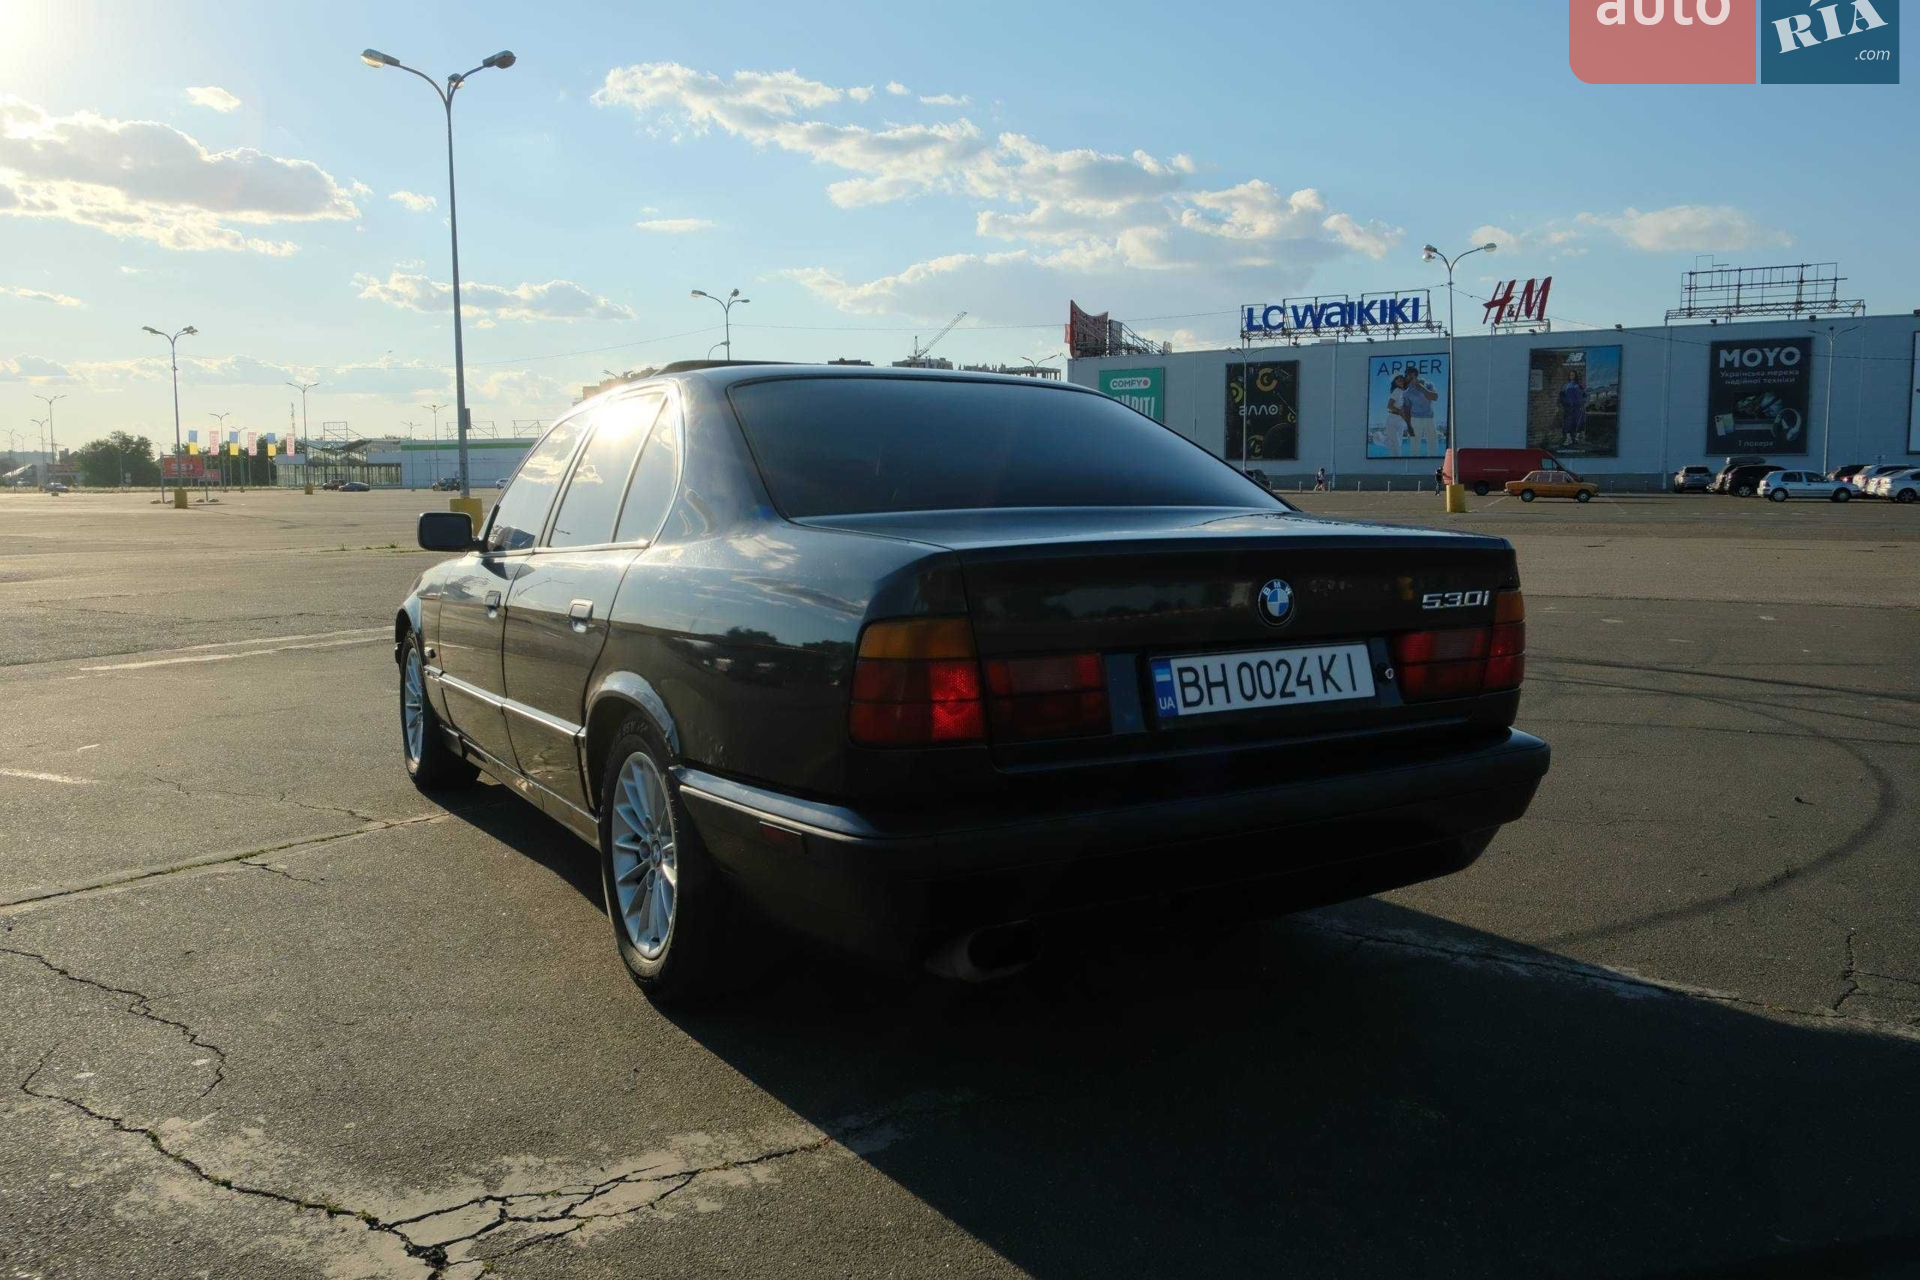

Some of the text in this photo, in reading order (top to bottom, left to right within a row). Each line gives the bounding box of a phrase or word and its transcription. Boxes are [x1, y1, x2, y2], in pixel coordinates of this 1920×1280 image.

[1482, 276, 1552, 325] H&M
[1246, 305, 1286, 332] LC
[1719, 346, 1801, 368] MOYO
[1111, 379, 1143, 388] COMFY
[1262, 581, 1293, 596] BMW
[1422, 590, 1490, 609] 530i
[1158, 697, 1176, 710] UA
